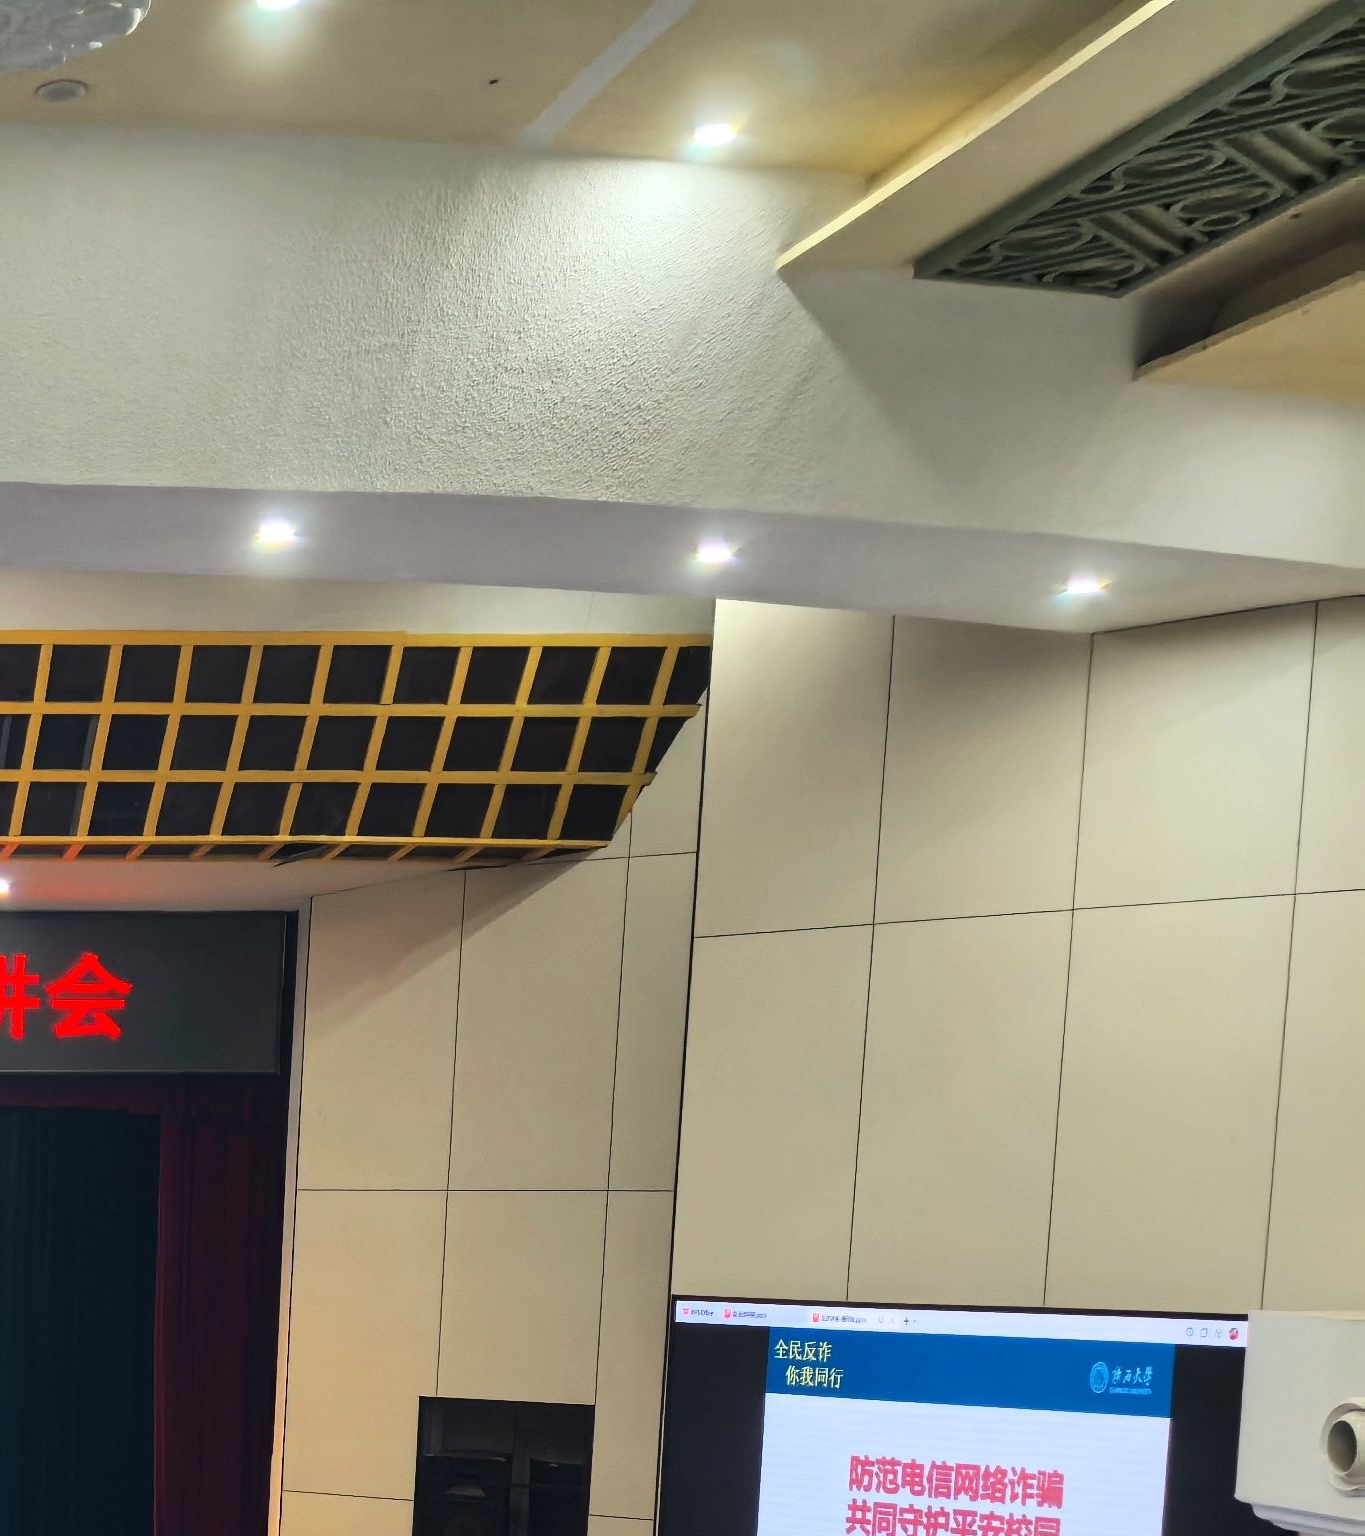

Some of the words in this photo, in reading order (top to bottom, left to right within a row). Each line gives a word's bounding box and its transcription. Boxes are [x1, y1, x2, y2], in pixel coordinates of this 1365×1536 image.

[774, 1338, 832, 1364] 全民反诈
[785, 1364, 844, 1390] 你我同行
[848, 1455, 1065, 1511] 防范电信网络诈骗
